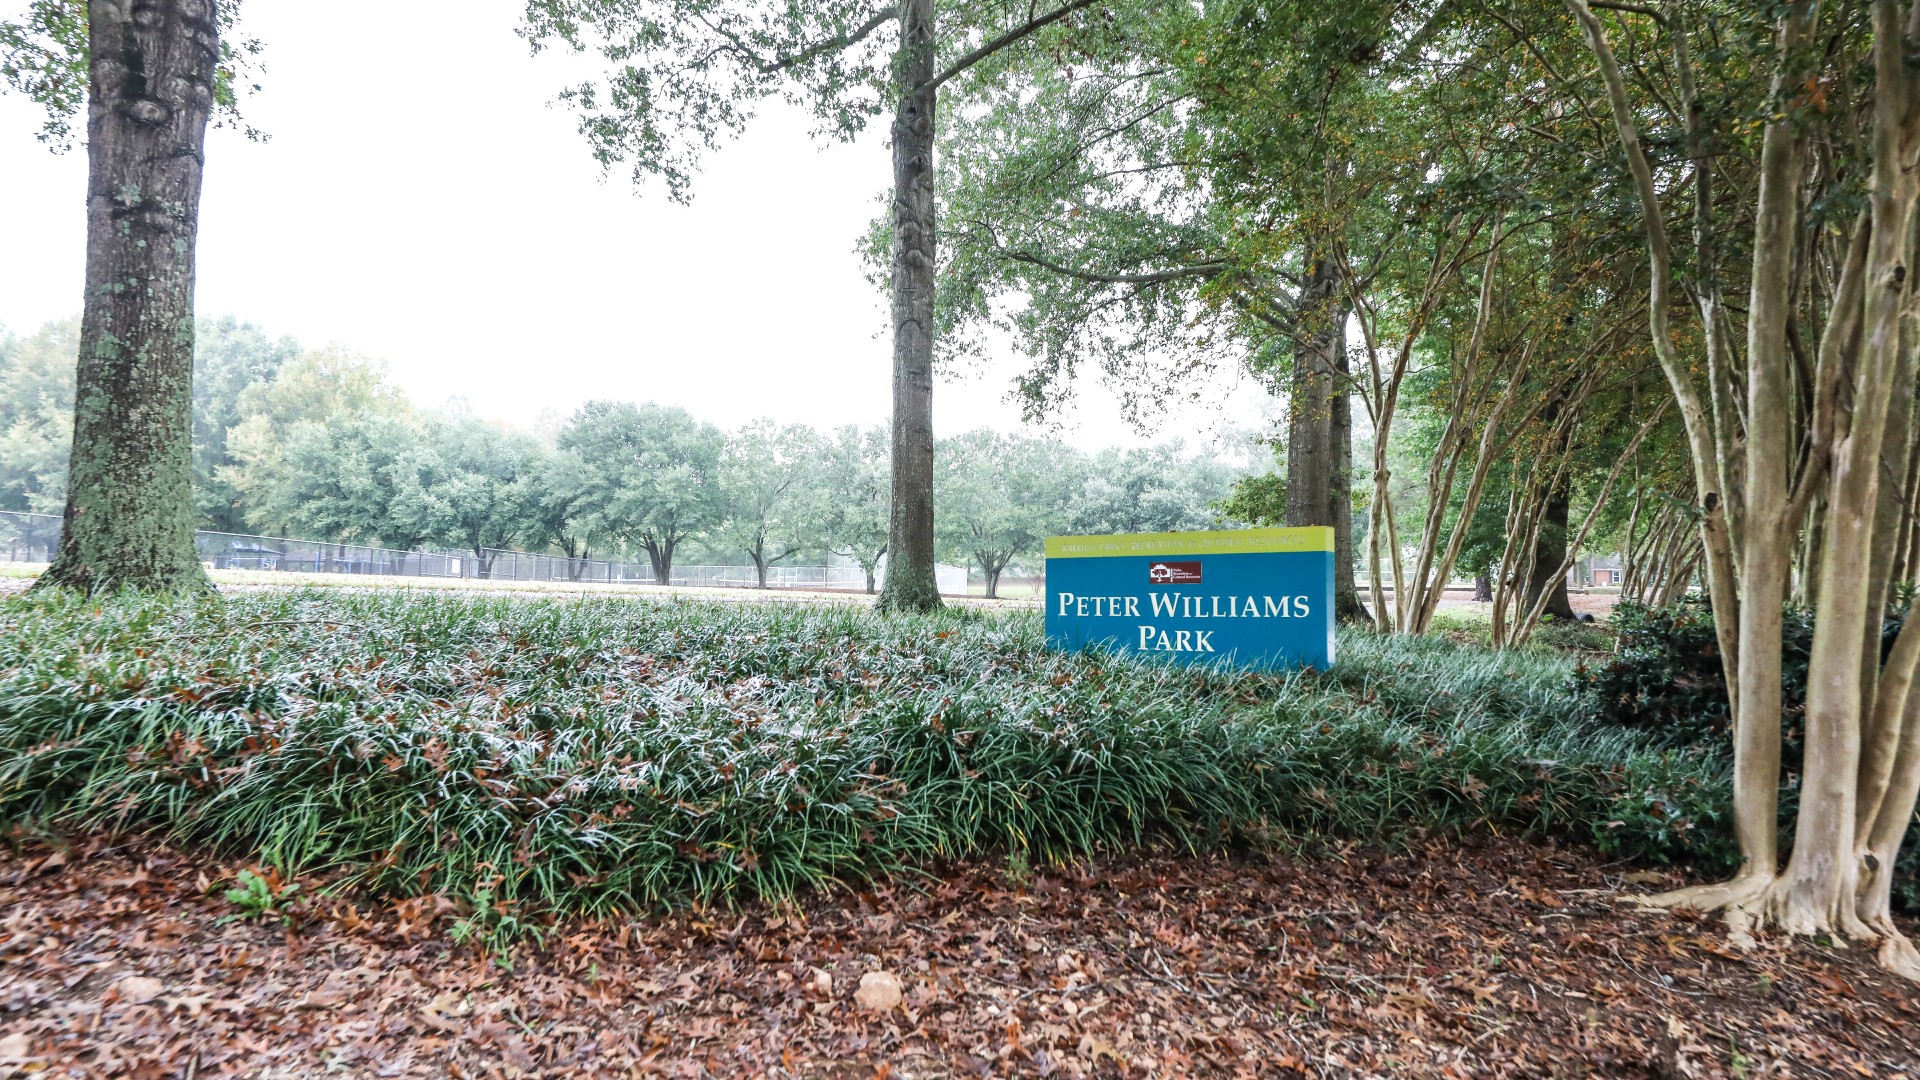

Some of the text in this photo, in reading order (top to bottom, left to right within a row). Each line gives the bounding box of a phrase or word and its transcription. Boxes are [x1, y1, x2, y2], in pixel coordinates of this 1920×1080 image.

[1058, 592, 1310, 618] PETER WILLIAMS
[1138, 625, 1215, 653] PARK
